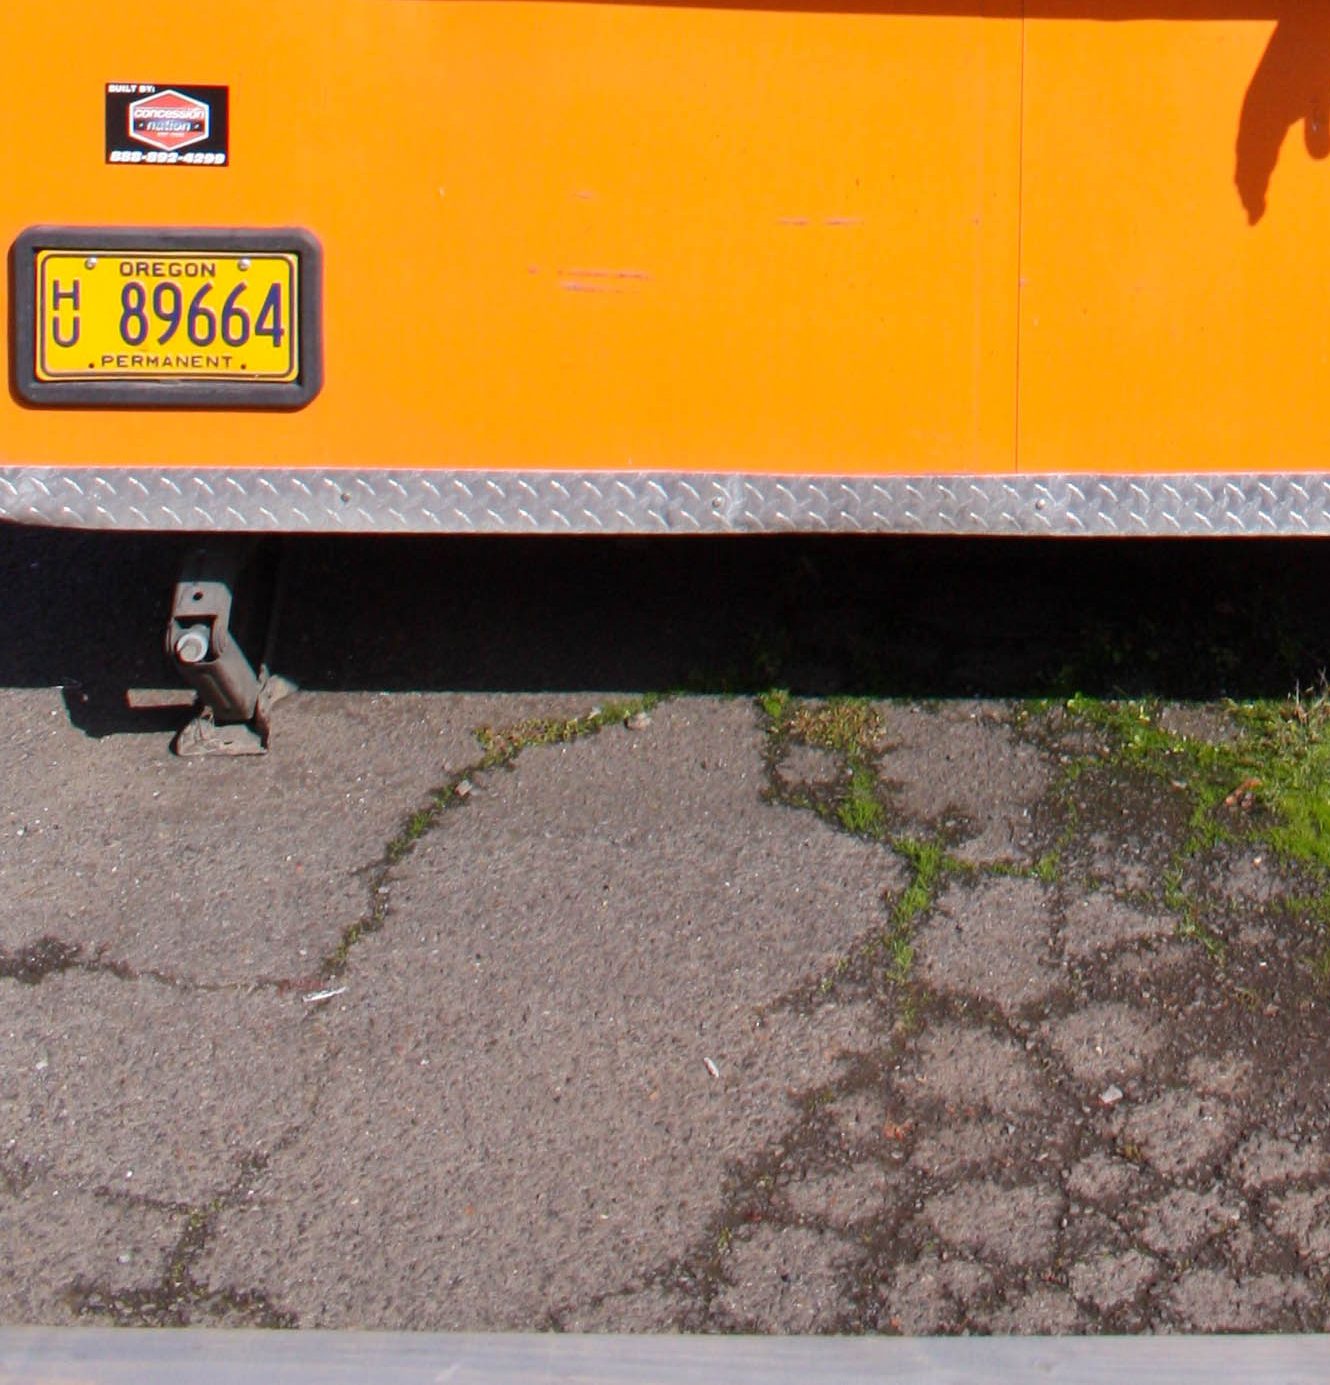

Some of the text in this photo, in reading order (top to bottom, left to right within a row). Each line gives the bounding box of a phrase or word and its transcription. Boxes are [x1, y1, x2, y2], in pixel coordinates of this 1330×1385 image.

[134, 107, 205, 119] concession
[146, 120, 192, 131] nation
[119, 261, 216, 277] OREGON
[120, 282, 285, 348] 89664
[101, 355, 233, 369] PERMANENT
